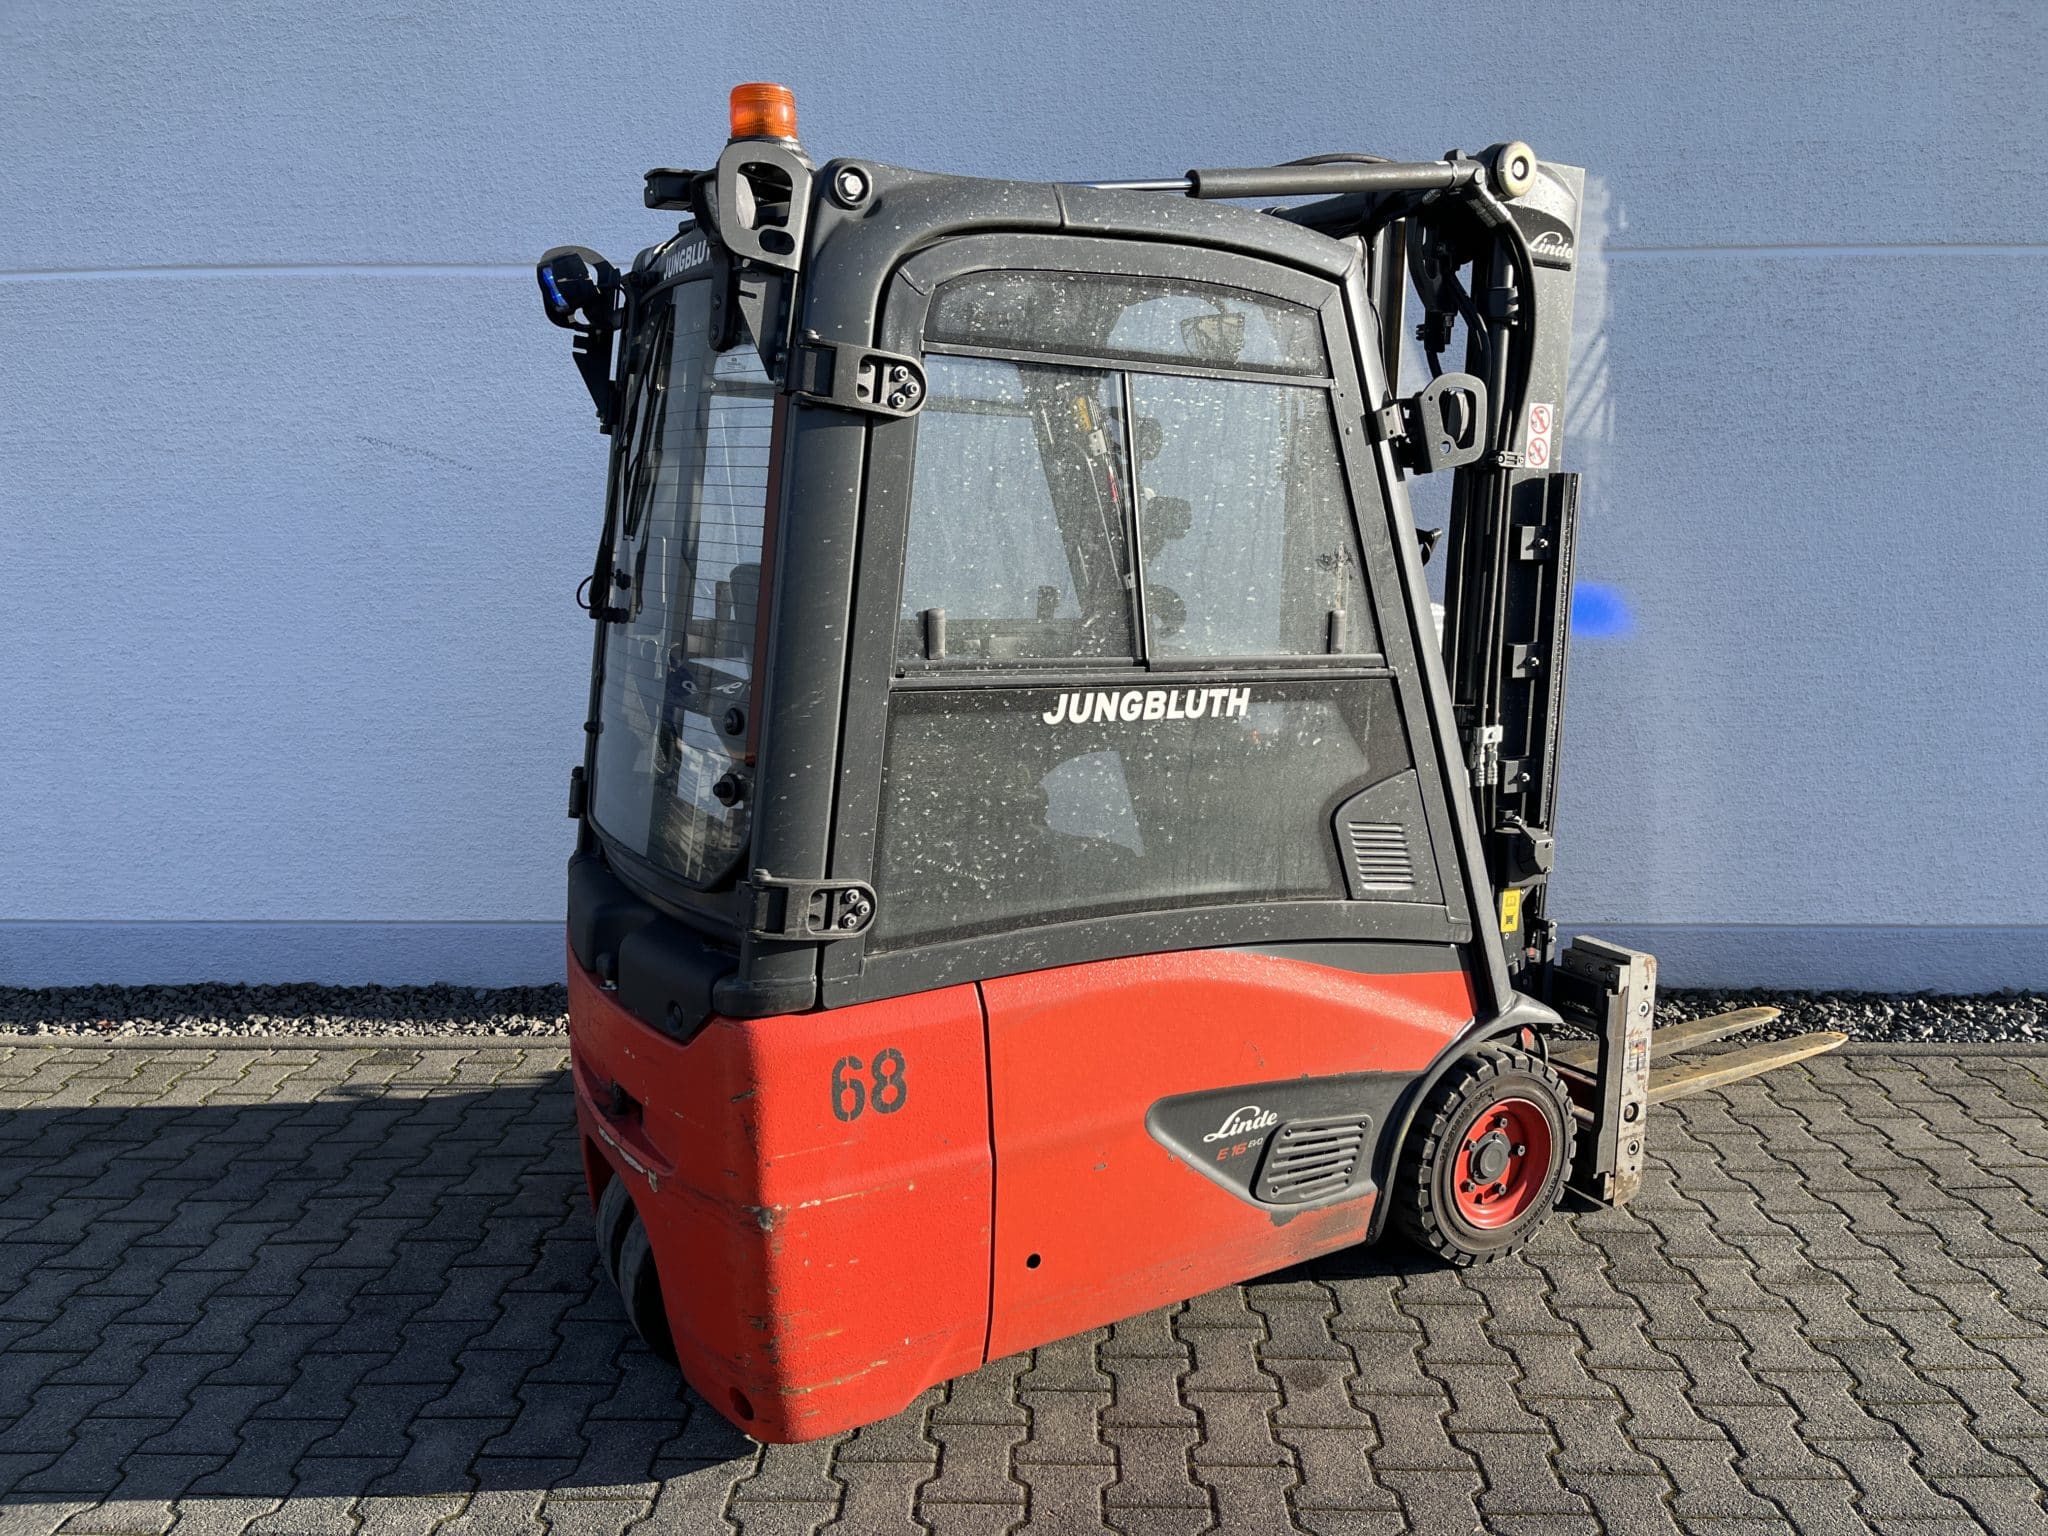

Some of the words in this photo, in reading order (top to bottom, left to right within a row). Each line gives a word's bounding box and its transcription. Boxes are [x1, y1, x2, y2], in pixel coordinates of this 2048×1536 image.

[1529, 231, 1574, 259] Linde
[1042, 687, 1251, 725] JUNGBLUTH
[831, 1047, 908, 1123] 68
[1202, 1105, 1278, 1143] Linde
[1216, 1147, 1230, 1161] E
